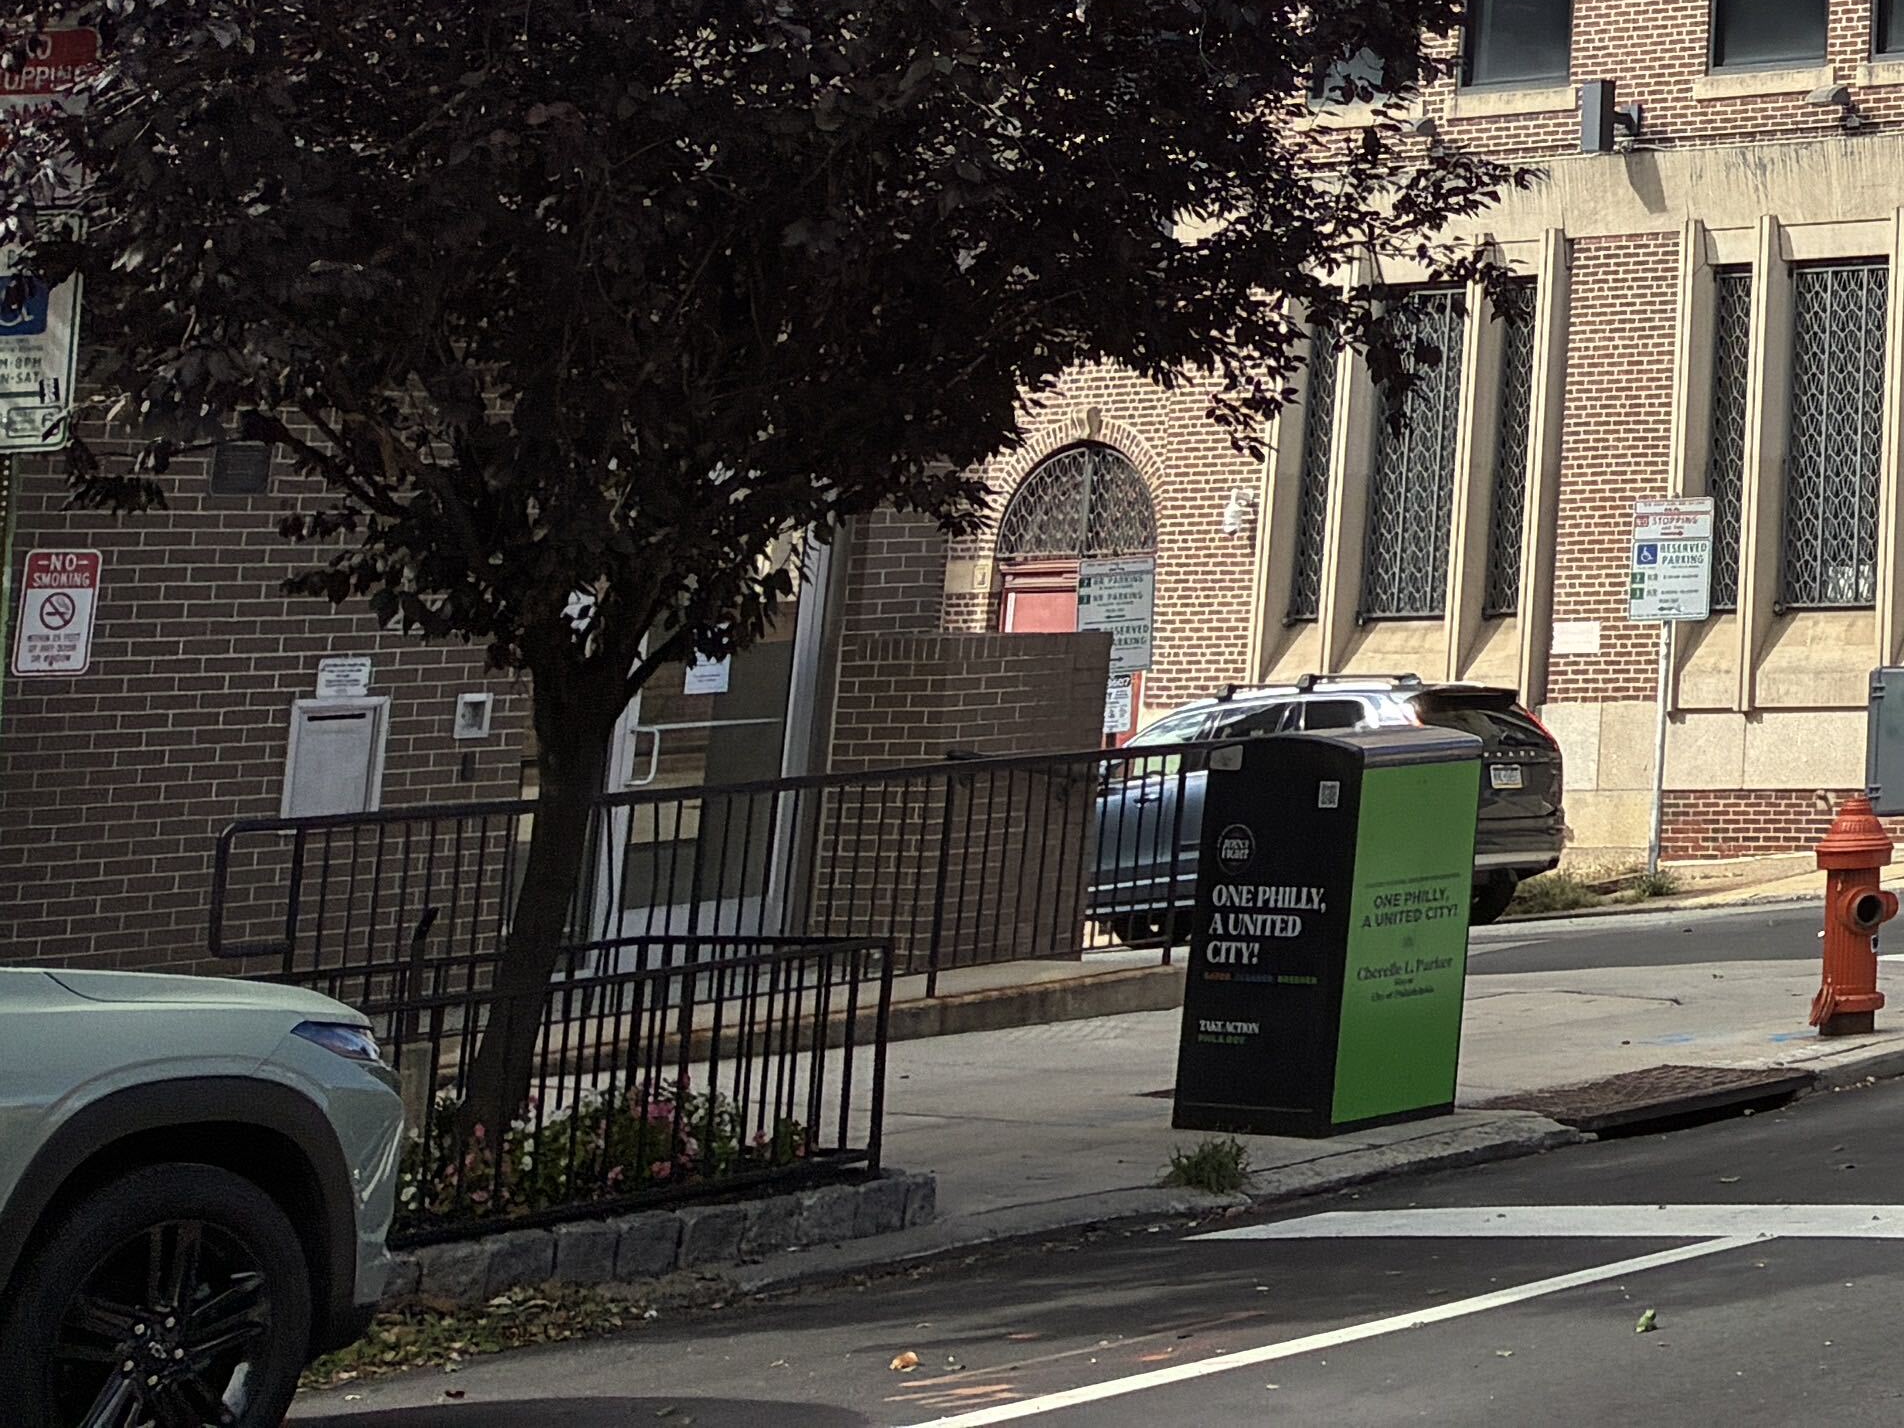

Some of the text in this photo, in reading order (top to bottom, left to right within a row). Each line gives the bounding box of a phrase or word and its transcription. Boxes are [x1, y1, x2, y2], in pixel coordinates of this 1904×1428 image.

[1660, 543, 1708, 554] RESERVED
[49, 553, 78, 572] NO
[1662, 555, 1704, 565] PARKING
[32, 571, 91, 587] SMOKING
[1104, 624, 1149, 635] SERVED
[1212, 884, 1327, 913] ONE PHILLY,
[1374, 887, 1450, 909] ONE PHILLY,
[1208, 913, 1302, 937] A UNITED
[1361, 904, 1458, 928] A UNITED CITY!
[1206, 941, 1260, 965] CITY!
